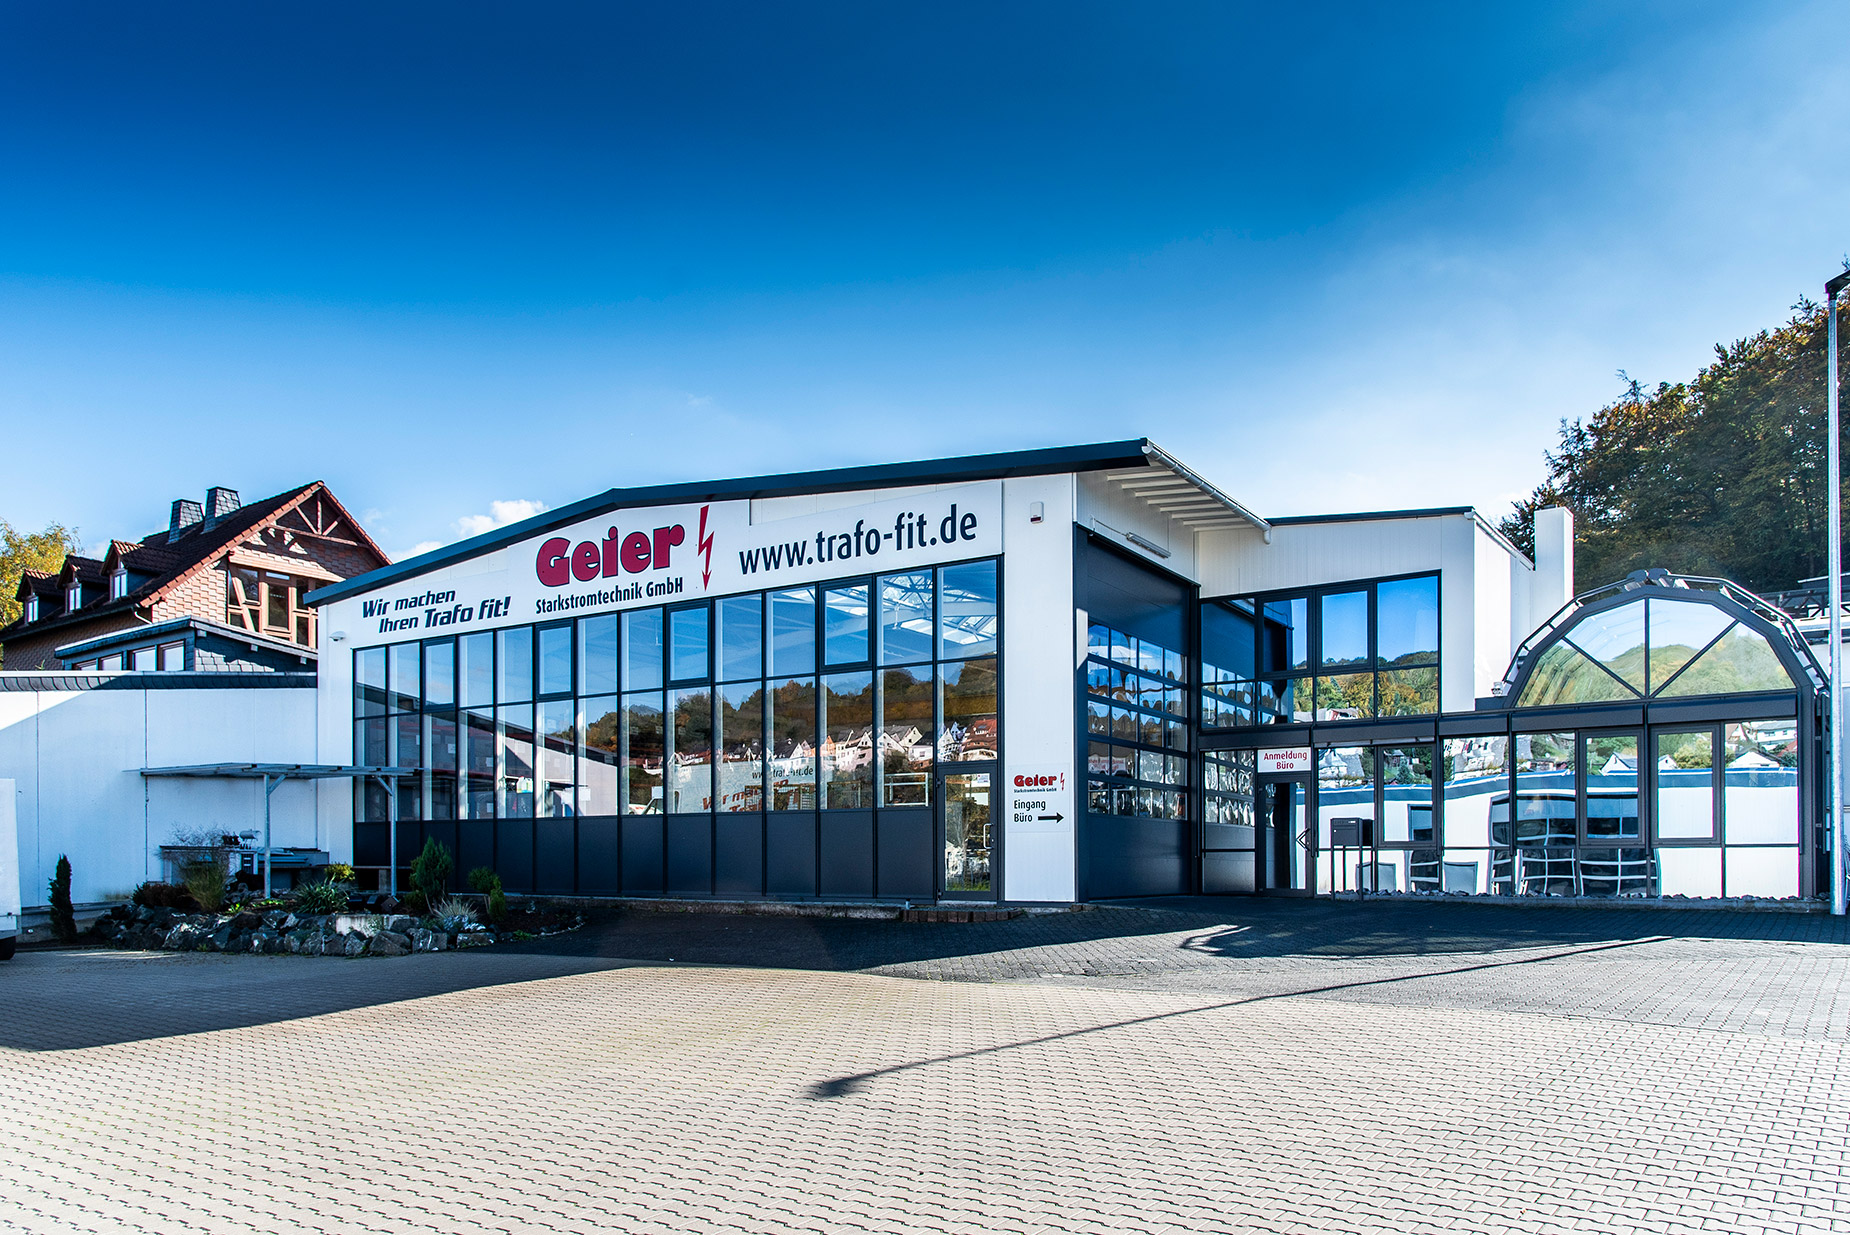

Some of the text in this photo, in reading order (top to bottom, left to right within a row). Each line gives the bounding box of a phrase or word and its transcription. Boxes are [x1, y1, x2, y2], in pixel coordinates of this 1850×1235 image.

[739, 503, 978, 575] www.trafo-fit.de
[536, 524, 685, 587] Geier
[362, 590, 456, 618] Wir machen
[536, 577, 683, 614] Starkstromtechnik GmbH
[379, 596, 512, 633] Ihren Trafo fit!
[1263, 751, 1308, 761] Anmeldung
[1276, 761, 1294, 770] Büro
[1014, 774, 1057, 787] Geier
[1014, 800, 1046, 811] Eingang
[1014, 812, 1033, 822] Büro
